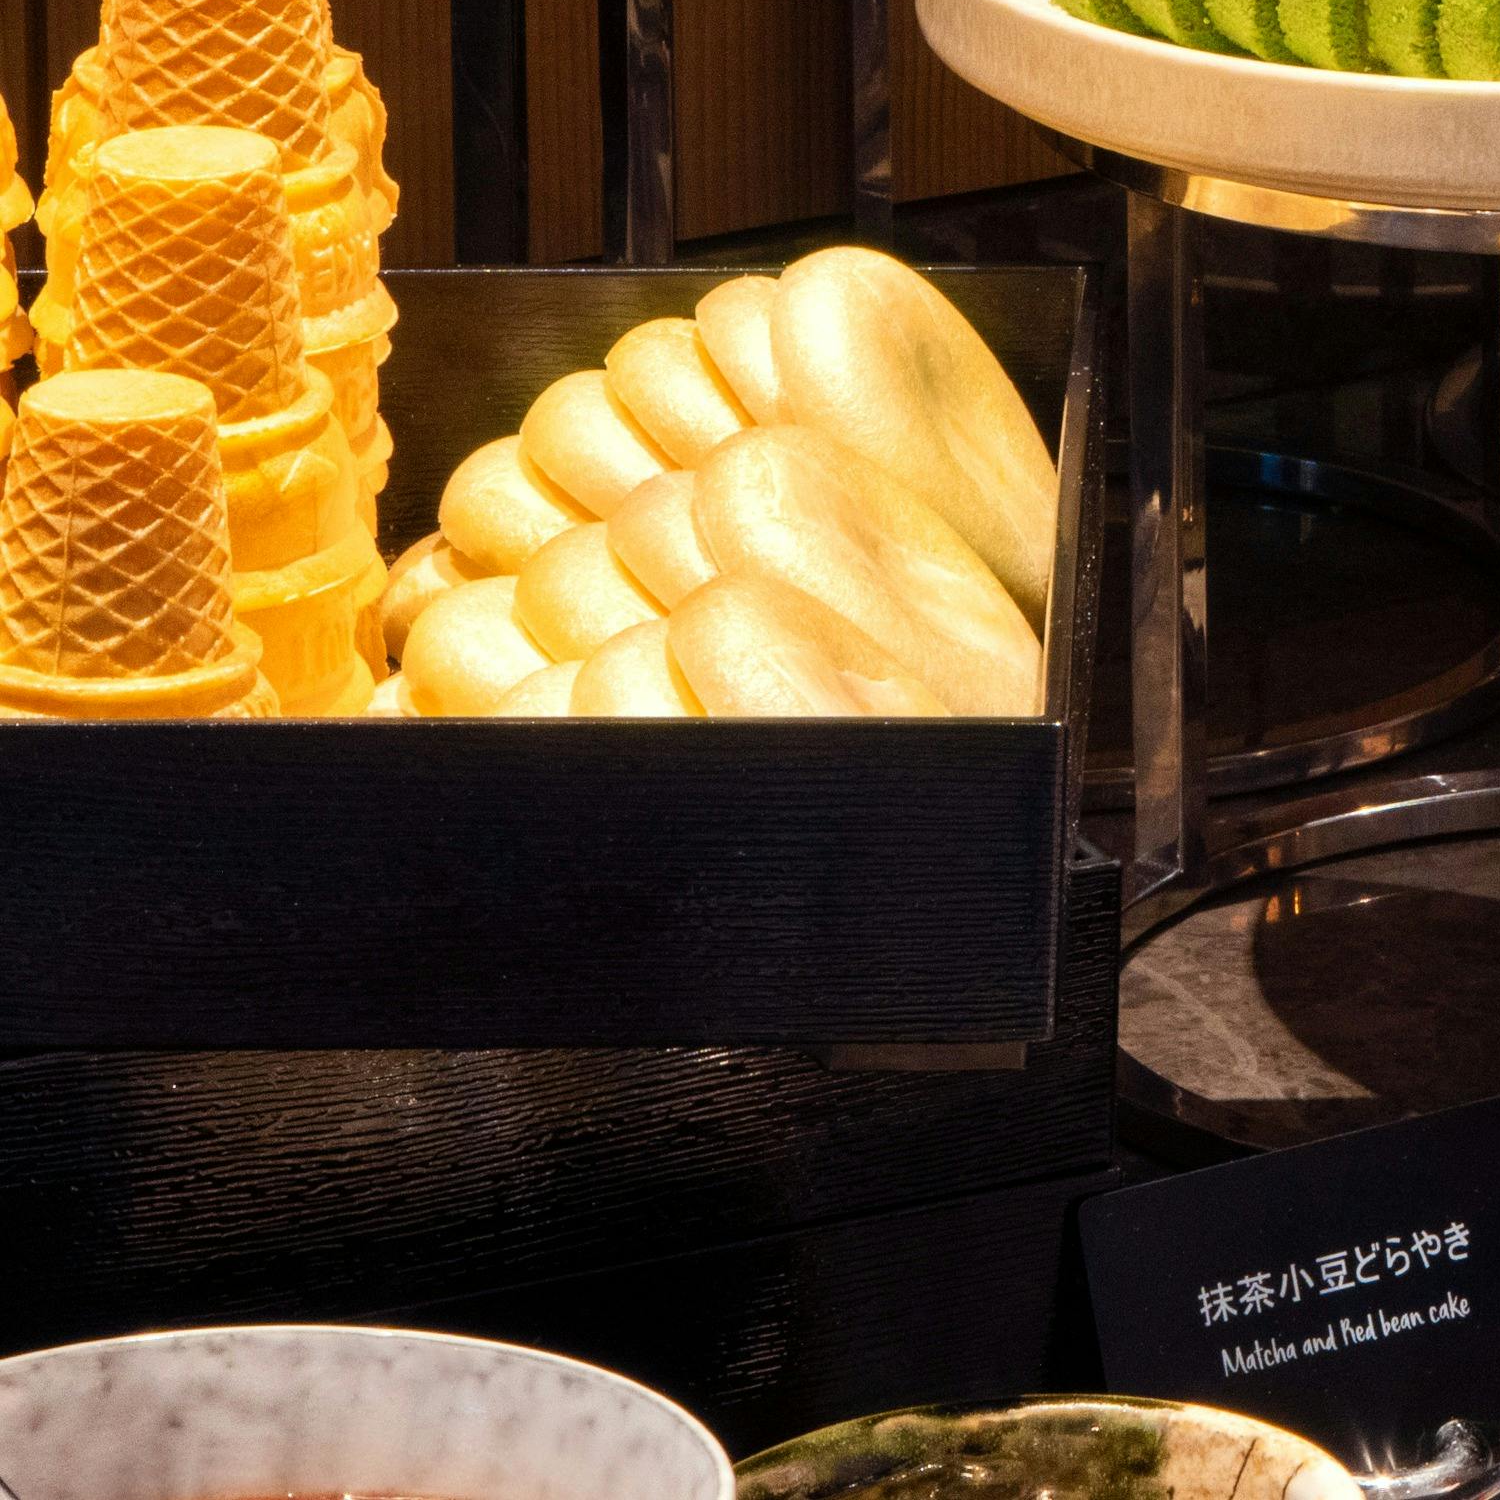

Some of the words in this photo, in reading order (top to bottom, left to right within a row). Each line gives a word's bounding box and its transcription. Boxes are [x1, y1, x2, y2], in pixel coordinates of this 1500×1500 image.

[1197, 1221, 1471, 1327] 抹茶小豆どらやき
[1221, 1338, 1297, 1377] Matcha
[1302, 1324, 1338, 1356] and
[1340, 1313, 1378, 1346] Red
[1378, 1309, 1425, 1337] bean
[1429, 1291, 1470, 1324] cake
